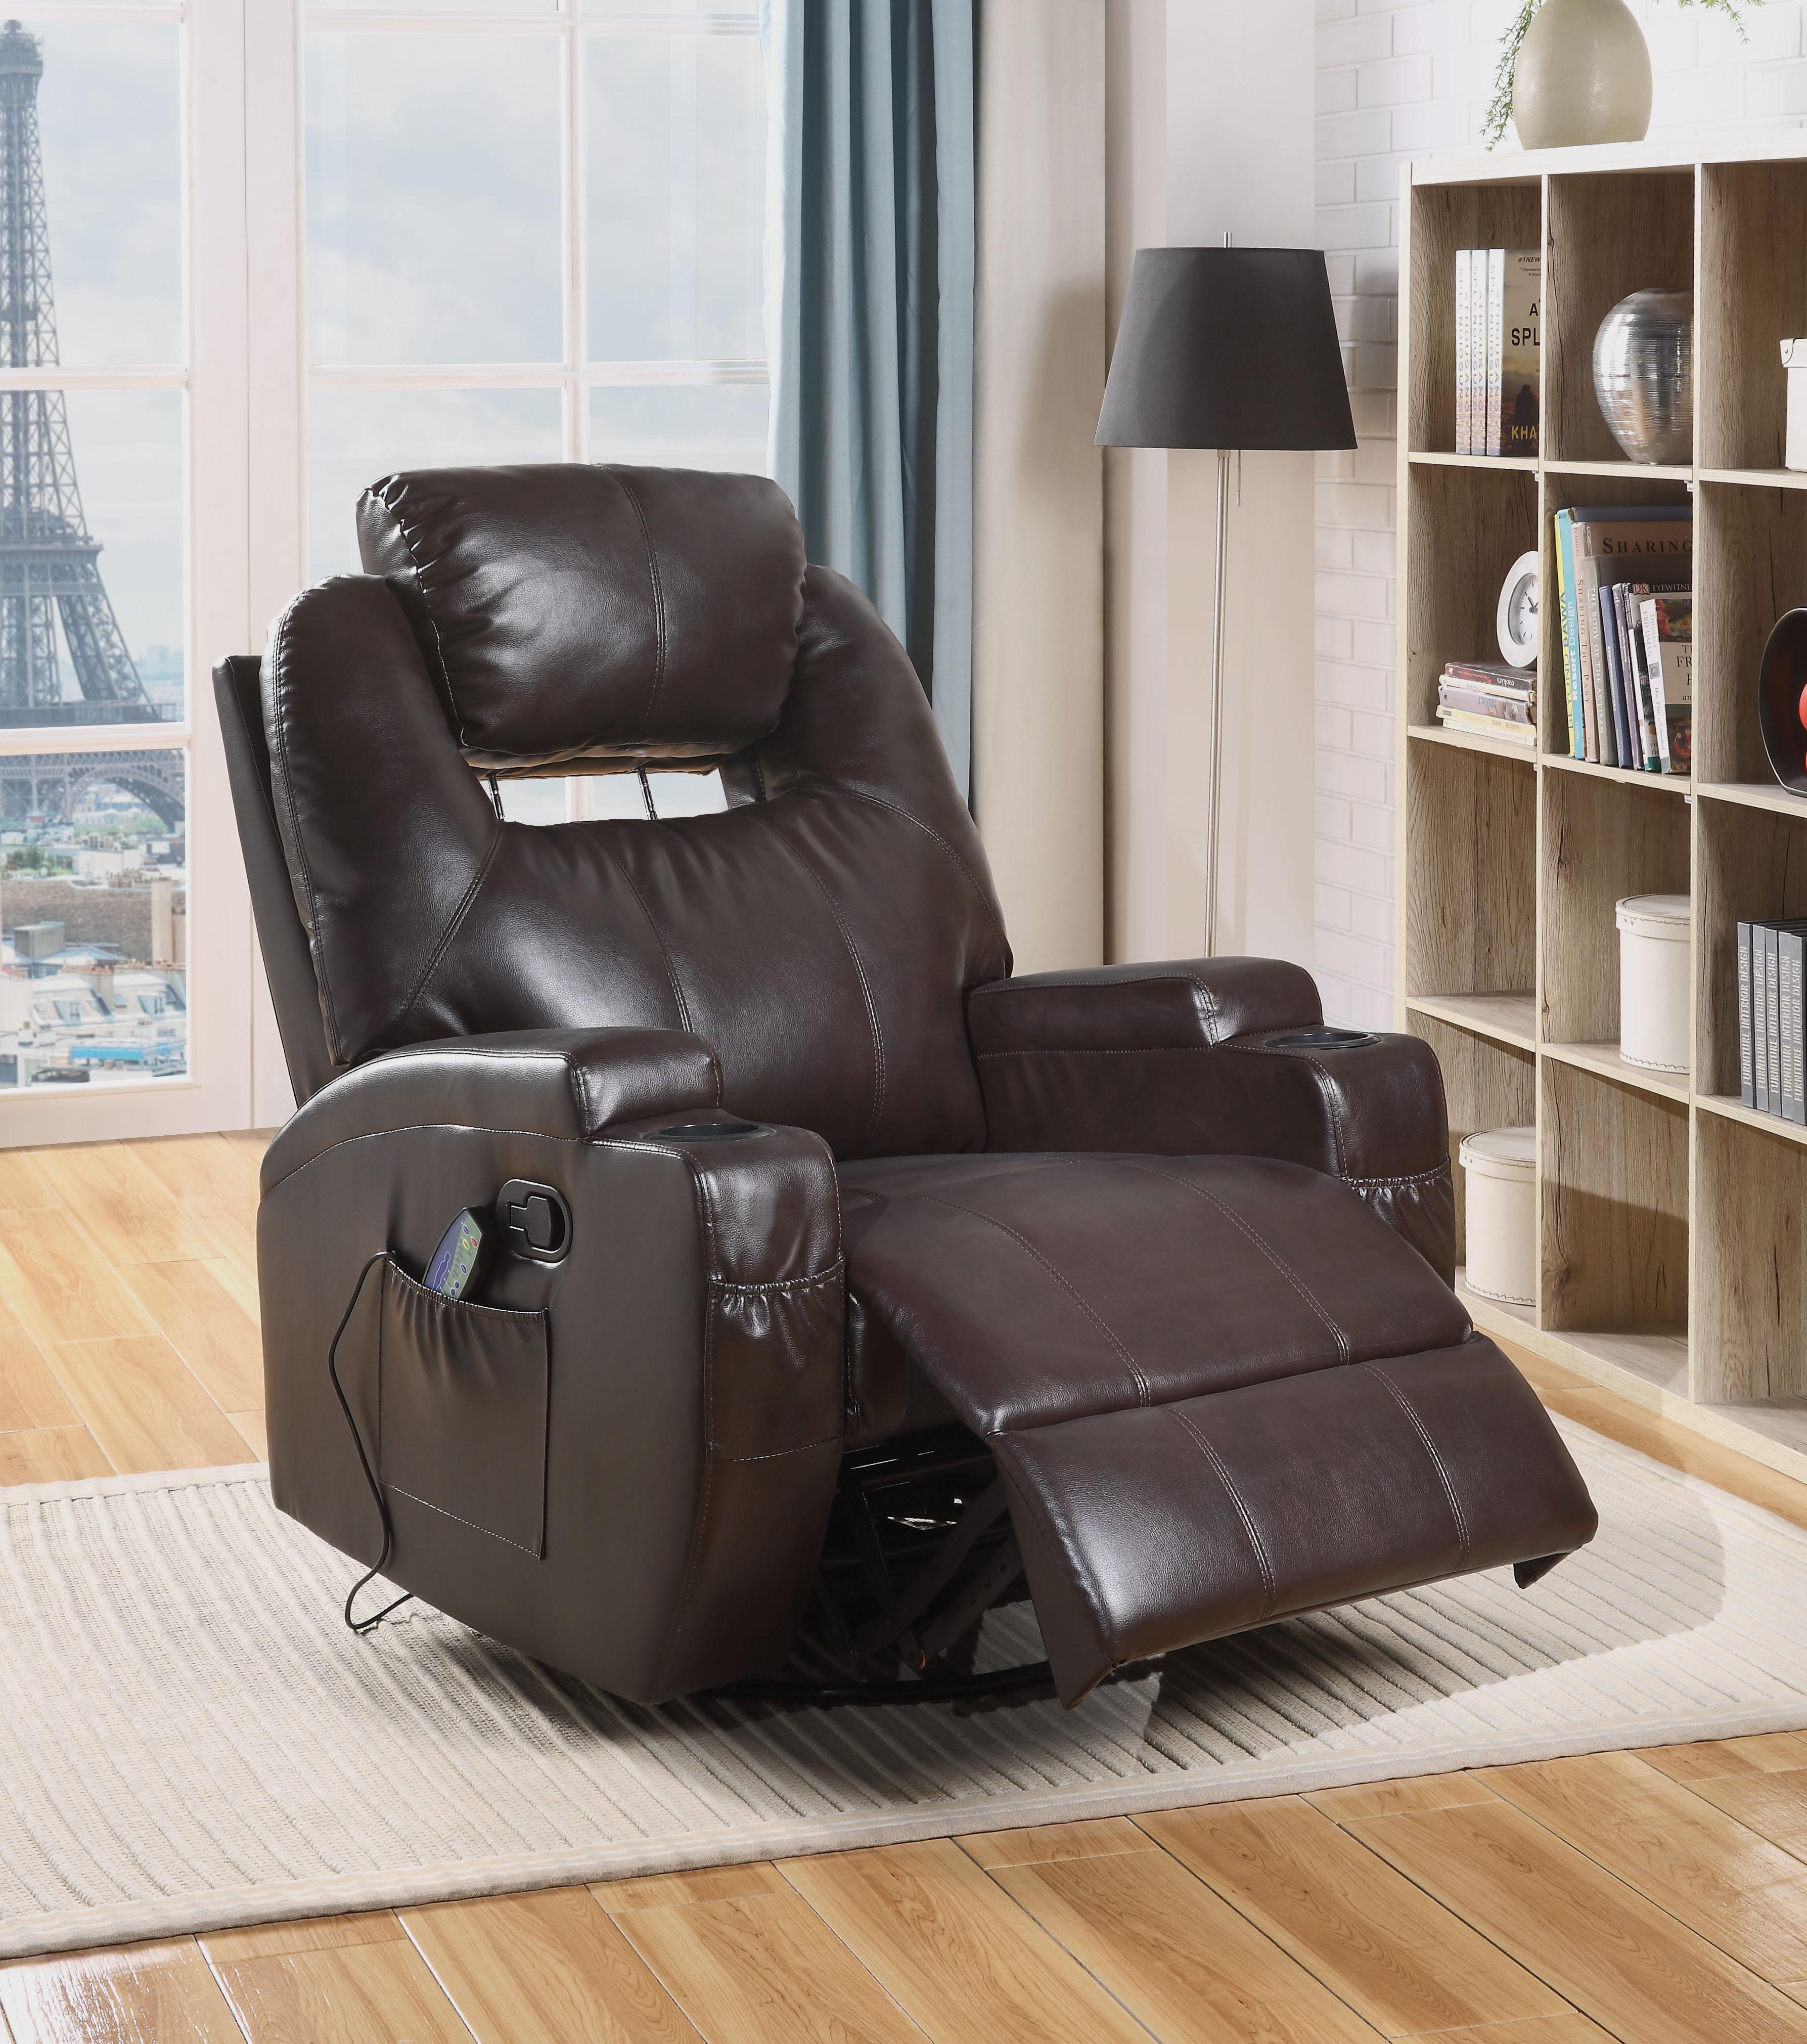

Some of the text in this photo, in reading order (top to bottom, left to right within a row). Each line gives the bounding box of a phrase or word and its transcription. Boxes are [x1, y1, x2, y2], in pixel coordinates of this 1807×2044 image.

[1511, 328, 1540, 346] SPL
[1511, 426, 1537, 440] KHA
[1603, 538, 1692, 553] SHARING
[1577, 579, 1586, 634] SHARING
[1634, 584, 1648, 593] DK
[1594, 644, 1600, 657] OF
[1740, 946, 1751, 1085] FURNITURE INTERIOR DESIGN
[1755, 949, 1766, 1089] FURNITURE INTERIOR DESIGN
[1768, 953, 1779, 1094] FURNITURE INTERIOR DESIGN
[1781, 956, 1792, 1097] FURNITURE INTERIOR DESIGN
[1792, 960, 1803, 1102] FURNITURE INTERIOR DESIGN
